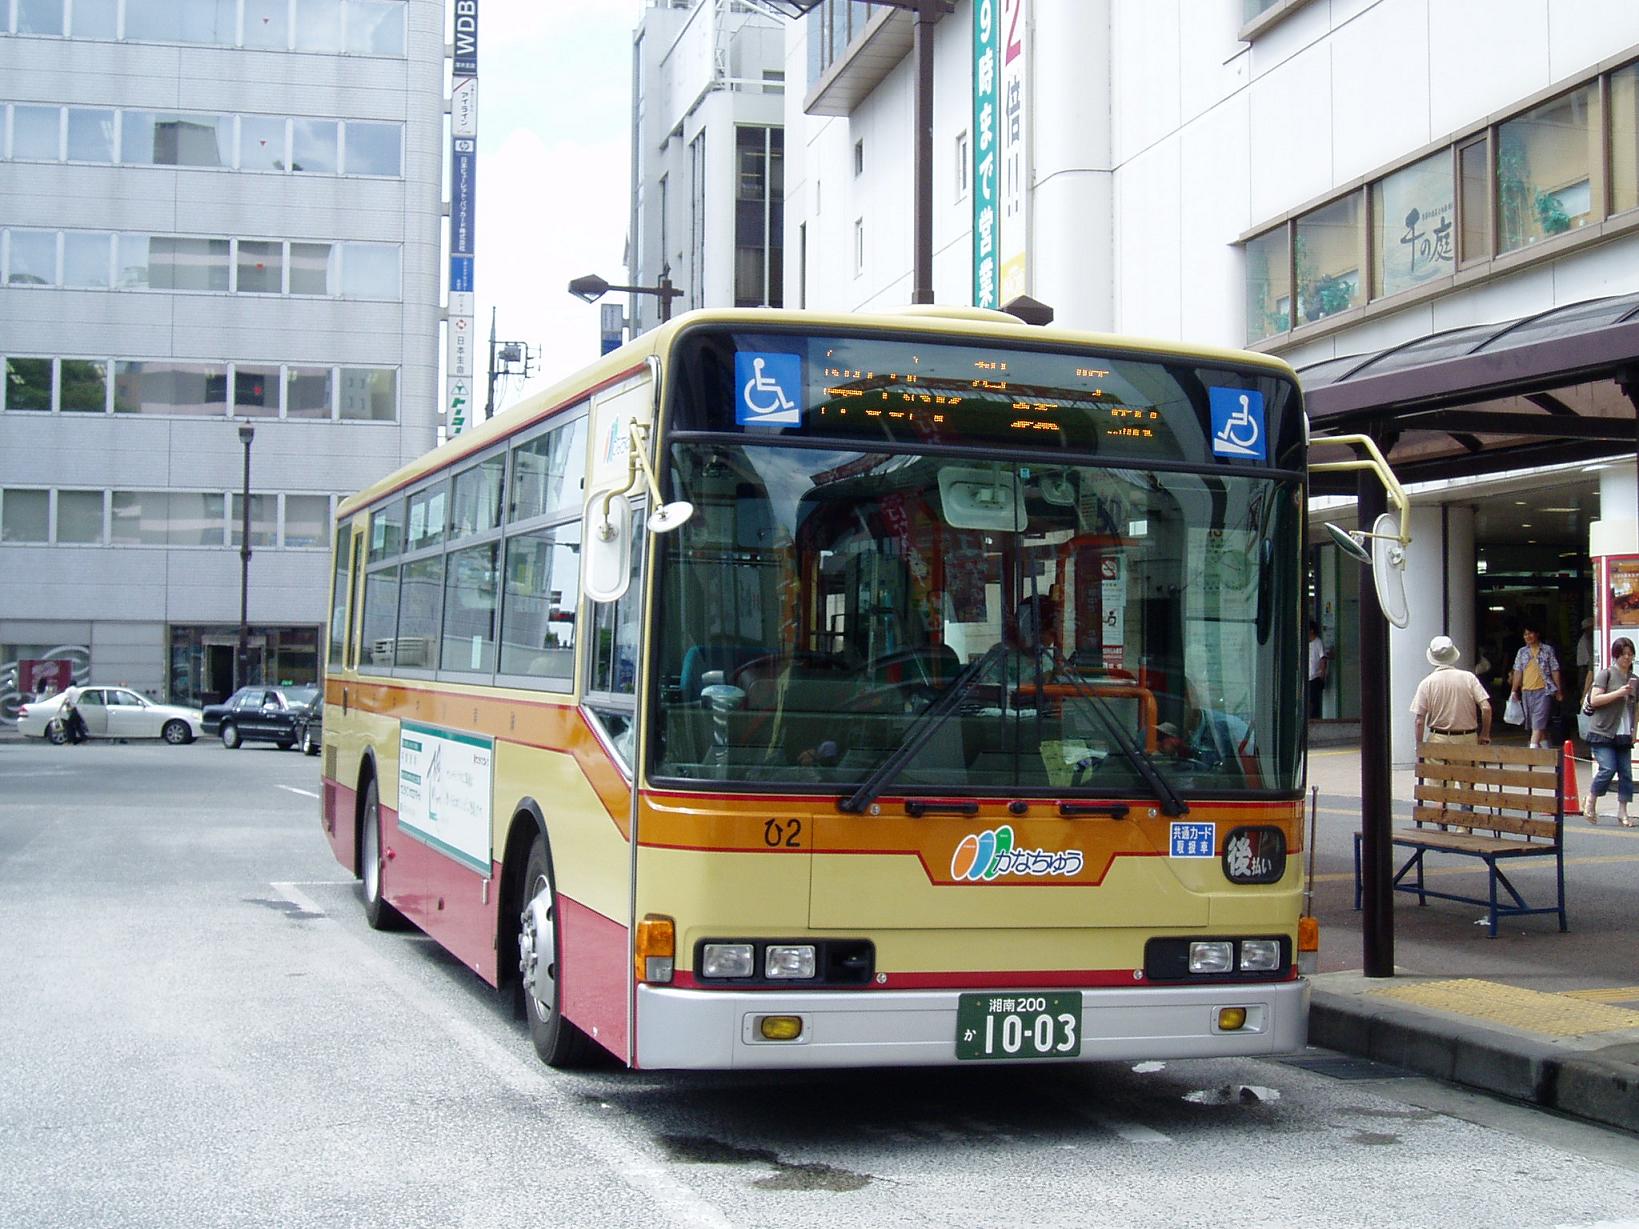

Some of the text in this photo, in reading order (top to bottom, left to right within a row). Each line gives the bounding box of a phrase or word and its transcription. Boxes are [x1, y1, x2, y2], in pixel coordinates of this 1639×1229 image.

[457, 1, 475, 54] WDB
[1173, 826, 1212, 840] 共通カード
[992, 848, 1083, 875] かなちゅう
[1227, 833, 1272, 876] 後払い
[985, 1013, 1076, 1054] 10-03
